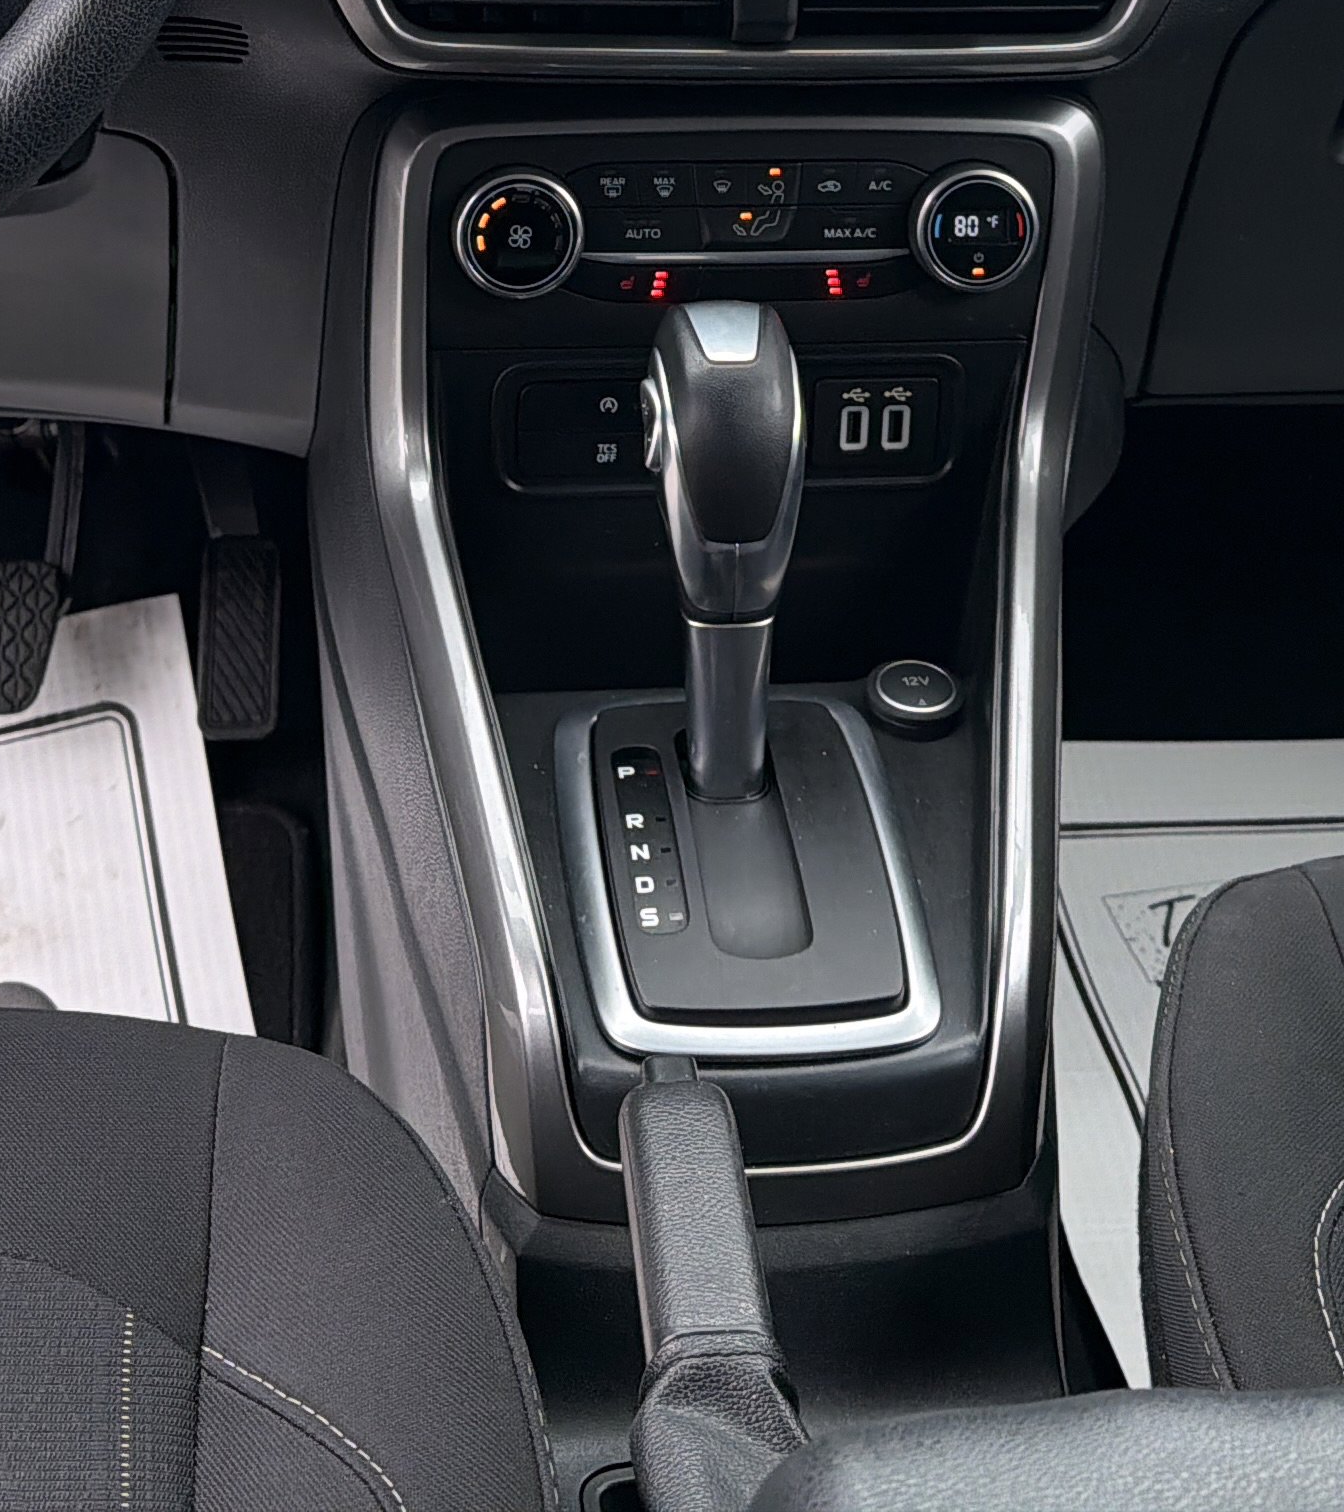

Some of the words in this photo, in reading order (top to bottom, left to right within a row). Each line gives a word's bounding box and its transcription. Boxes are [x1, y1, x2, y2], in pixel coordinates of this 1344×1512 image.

[599, 177, 626, 188] REAR
[653, 177, 676, 187] MAX
[868, 179, 893, 192] A/C
[954, 215, 979, 237] 80
[625, 227, 661, 240] AUTO
[824, 227, 853, 239] MAX
[854, 227, 877, 240] A/C
[597, 443, 618, 455] TCS
[596, 452, 618, 464] OFF
[902, 675, 930, 687] 12V
[618, 766, 635, 779] P
[626, 813, 644, 829] R
[631, 844, 650, 861] N
[635, 876, 654, 894] D
[640, 908, 659, 927] S
